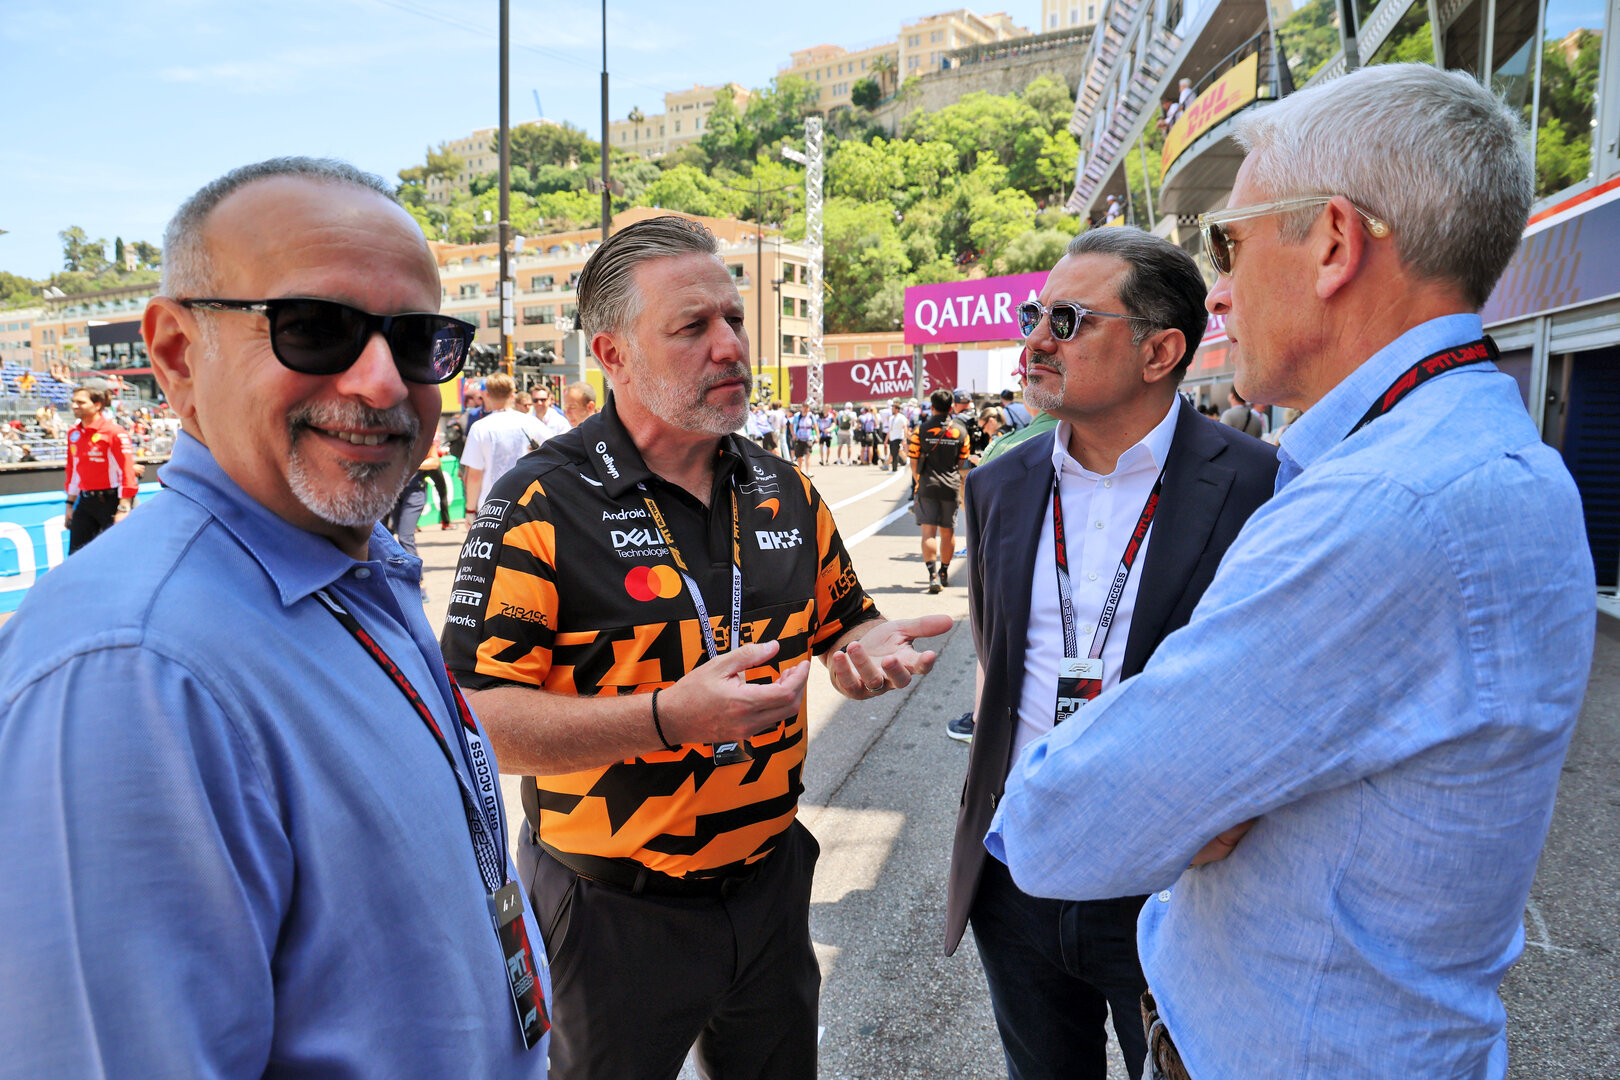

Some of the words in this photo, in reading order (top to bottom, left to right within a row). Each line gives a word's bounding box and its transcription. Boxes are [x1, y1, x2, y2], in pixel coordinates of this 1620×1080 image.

[915, 292, 1013, 336] QATAR
[870, 377, 931, 395] AIRWAS
[602, 453, 620, 479] allwyn
[485, 521, 501, 529] STAY
[602, 509, 646, 521] Android
[461, 536, 494, 560] okta
[610, 527, 665, 548] DELL
[755, 528, 802, 550] OKX
[615, 546, 669, 558] Technologie
[1101, 605, 1114, 628] GRID
[1109, 572, 1126, 605] ACCESS
[471, 741, 493, 792] ACCESS
[484, 797, 499, 831] GRID
[508, 948, 528, 981] PIT
